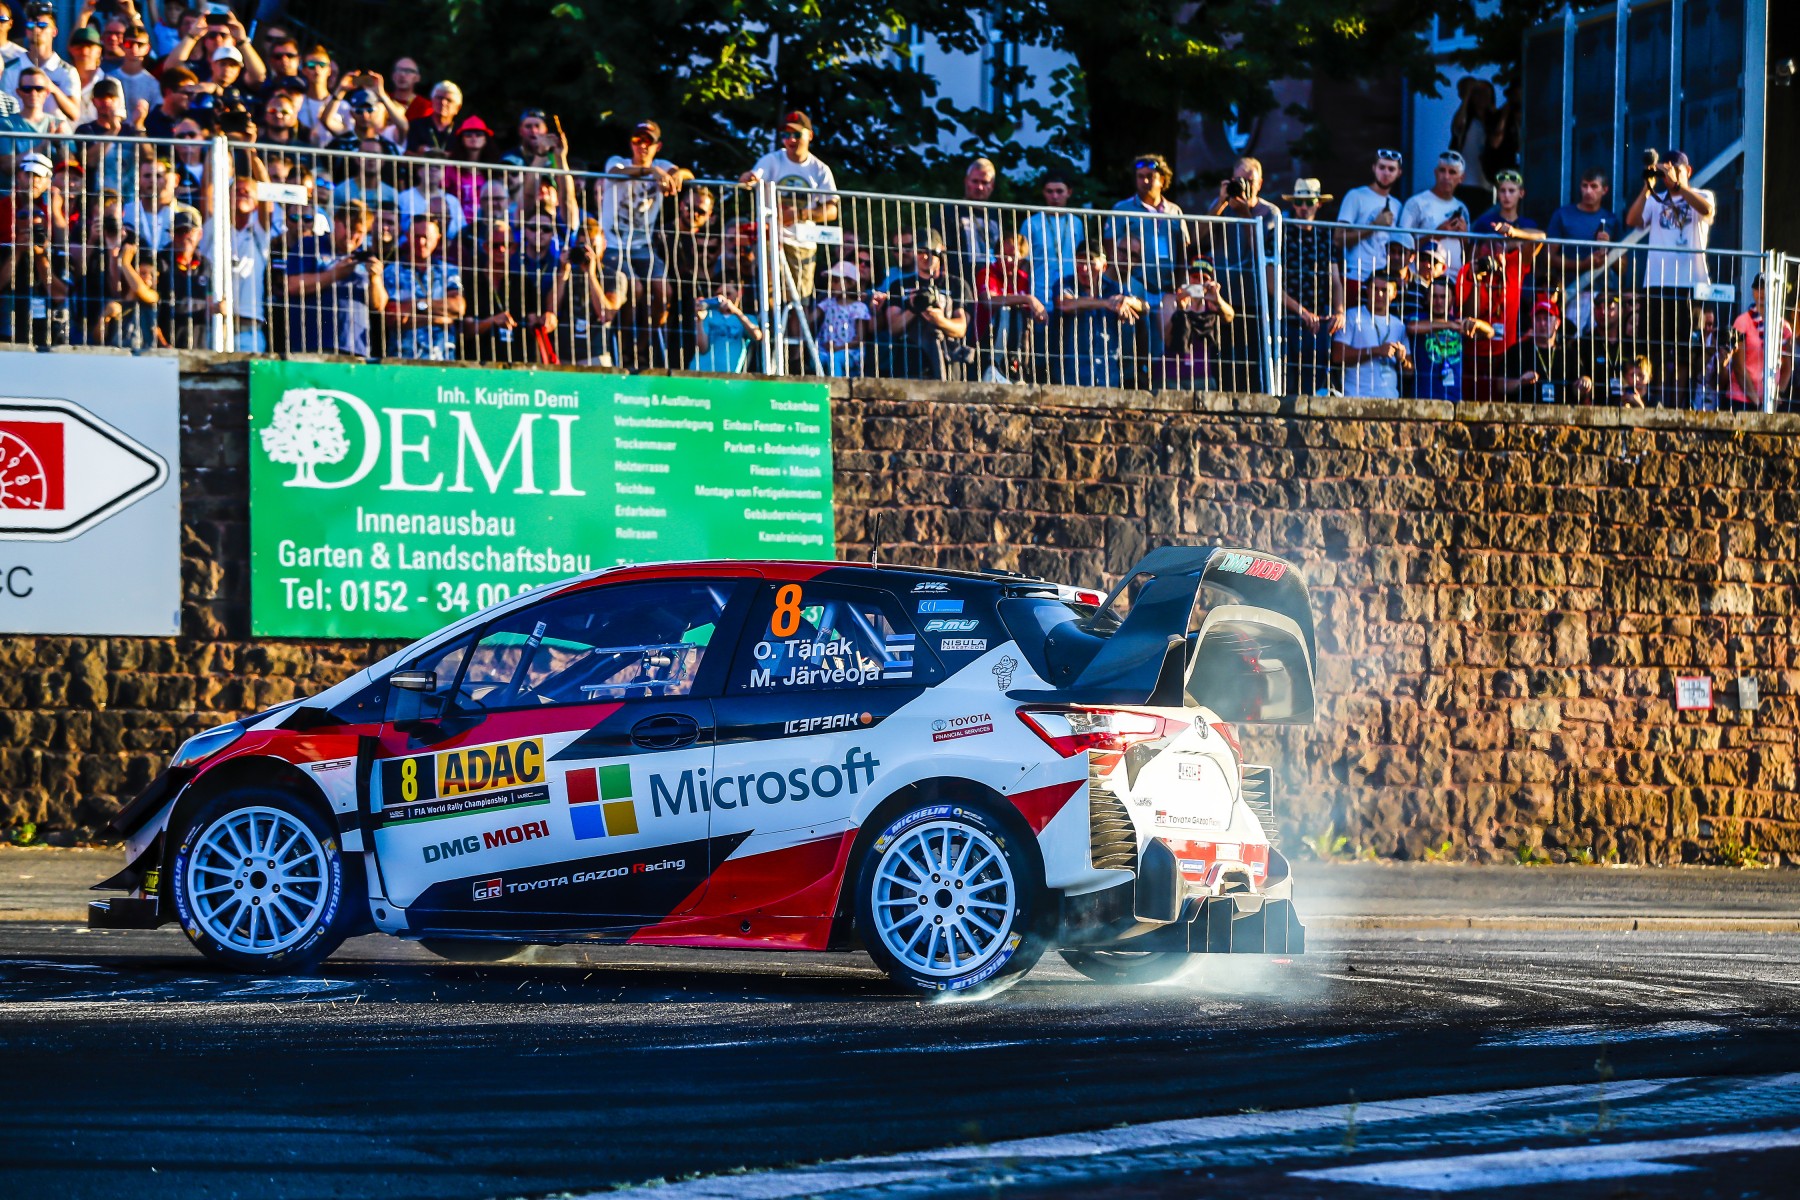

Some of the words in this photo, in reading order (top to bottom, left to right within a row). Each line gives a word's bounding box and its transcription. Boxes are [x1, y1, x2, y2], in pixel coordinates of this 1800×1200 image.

[437, 386, 470, 404] Inh.
[475, 387, 529, 408] Kujtim
[534, 389, 579, 408] Demi
[651, 394, 660, 406] &
[283, 388, 586, 496] DEMI
[14, 474, 31, 486] 8
[356, 506, 515, 537] Innenausbau
[278, 540, 363, 568] Garten
[370, 542, 390, 569] &
[398, 543, 591, 573] Landschaftsbau
[1243, 558, 1288, 582] MORI
[0, 566, 33, 598] C
[279, 577, 332, 612] Tel:
[339, 579, 409, 613] 0152
[436, 581, 470, 613] 34
[771, 583, 803, 638] 8
[753, 641, 777, 660] O.
[784, 637, 853, 659] Tänak
[750, 668, 776, 687] M.
[782, 666, 879, 686] Järveoja
[935, 732, 963, 740] FINANCIAL
[964, 726, 991, 735] SERVICES
[949, 713, 991, 727] TOYOTA
[401, 758, 418, 802] 8
[442, 740, 540, 795] ADAC
[649, 746, 881, 818] Microsoft
[414, 808, 426, 816] FIA
[427, 804, 446, 814] World
[447, 802, 463, 811] Rally
[464, 795, 508, 808] Championship
[892, 807, 949, 834] MICHELIN
[422, 835, 481, 864] DMG
[482, 819, 550, 850] MORI
[175, 858, 189, 919] MICHELIN
[325, 861, 341, 924] MICHELIN
[474, 885, 502, 900] GR
[506, 876, 569, 894] TOYOTA
[572, 866, 629, 884] GAZOO
[633, 858, 686, 874] Racing
[951, 953, 1007, 990] MICHELIN
